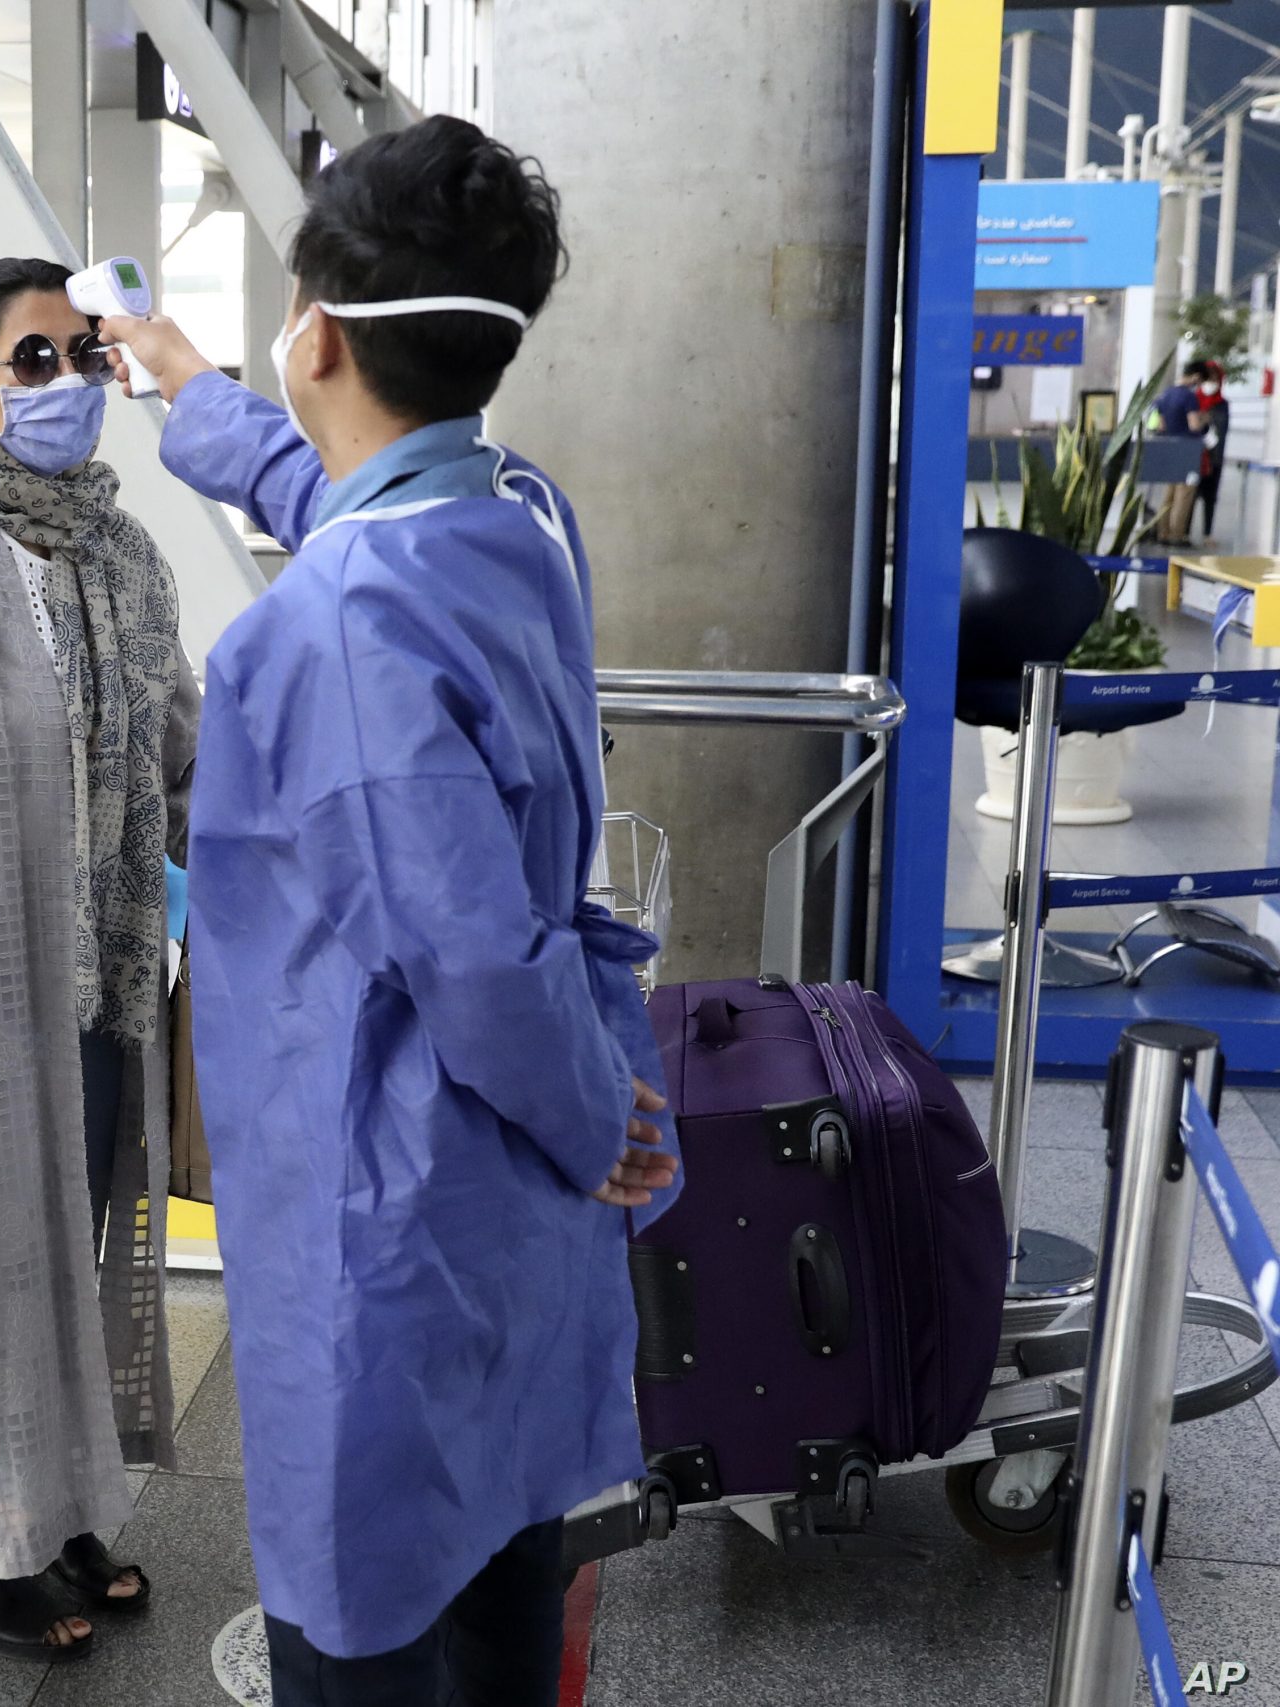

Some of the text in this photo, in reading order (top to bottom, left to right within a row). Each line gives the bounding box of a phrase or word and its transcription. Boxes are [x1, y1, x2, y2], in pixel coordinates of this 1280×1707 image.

[1091, 684, 1151, 696] Airport Service
[1071, 887, 1131, 898] Airport Service
